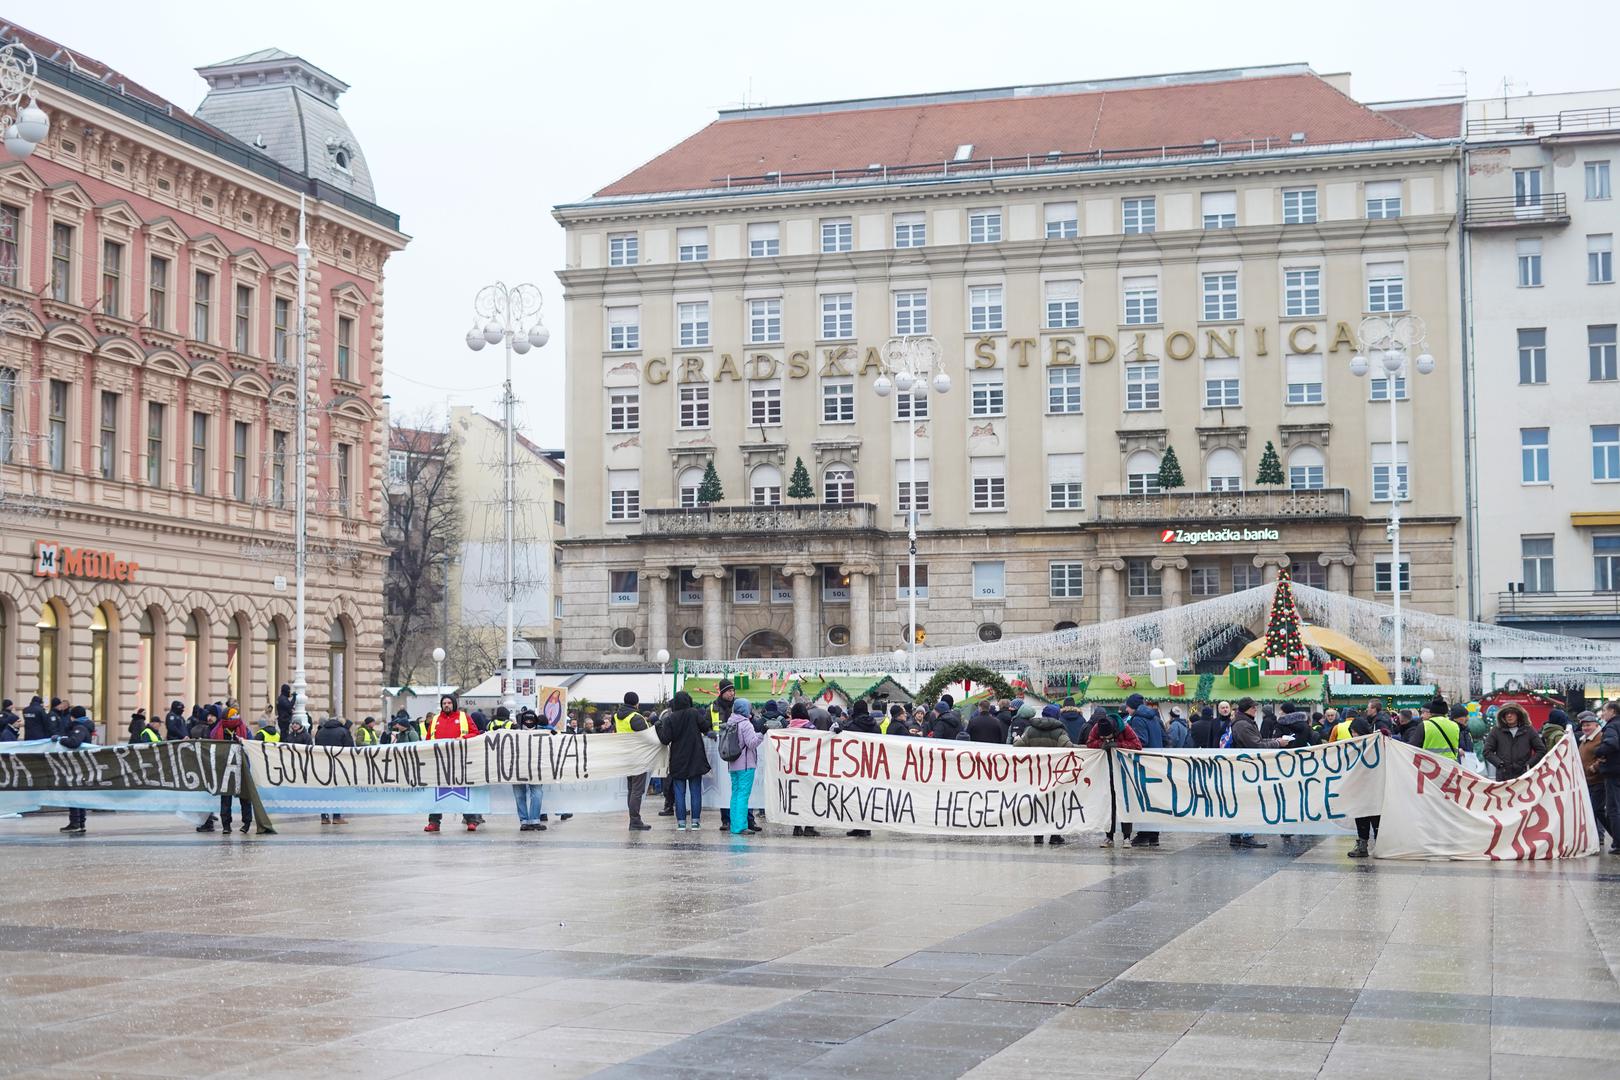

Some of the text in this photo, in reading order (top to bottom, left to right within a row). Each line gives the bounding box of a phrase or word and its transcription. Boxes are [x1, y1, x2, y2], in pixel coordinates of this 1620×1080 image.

[644, 320, 1358, 385] GRADSKA ŠTEDIONICA
[1175, 528, 1279, 545] Zagrebačka banka
[63, 547, 139, 582] Müller
[45, 751, 112, 787] NIJE
[113, 742, 241, 794] RELIGIJA
[261, 742, 351, 787] GOVOR
[434, 739, 474, 786] NIJE
[485, 733, 588, 784] MOLITVA!
[771, 735, 890, 779] TJELESNA
[778, 779, 1086, 830] NE CRKVENA HEGEMONIJA
[1257, 777, 1346, 824] ULICE
